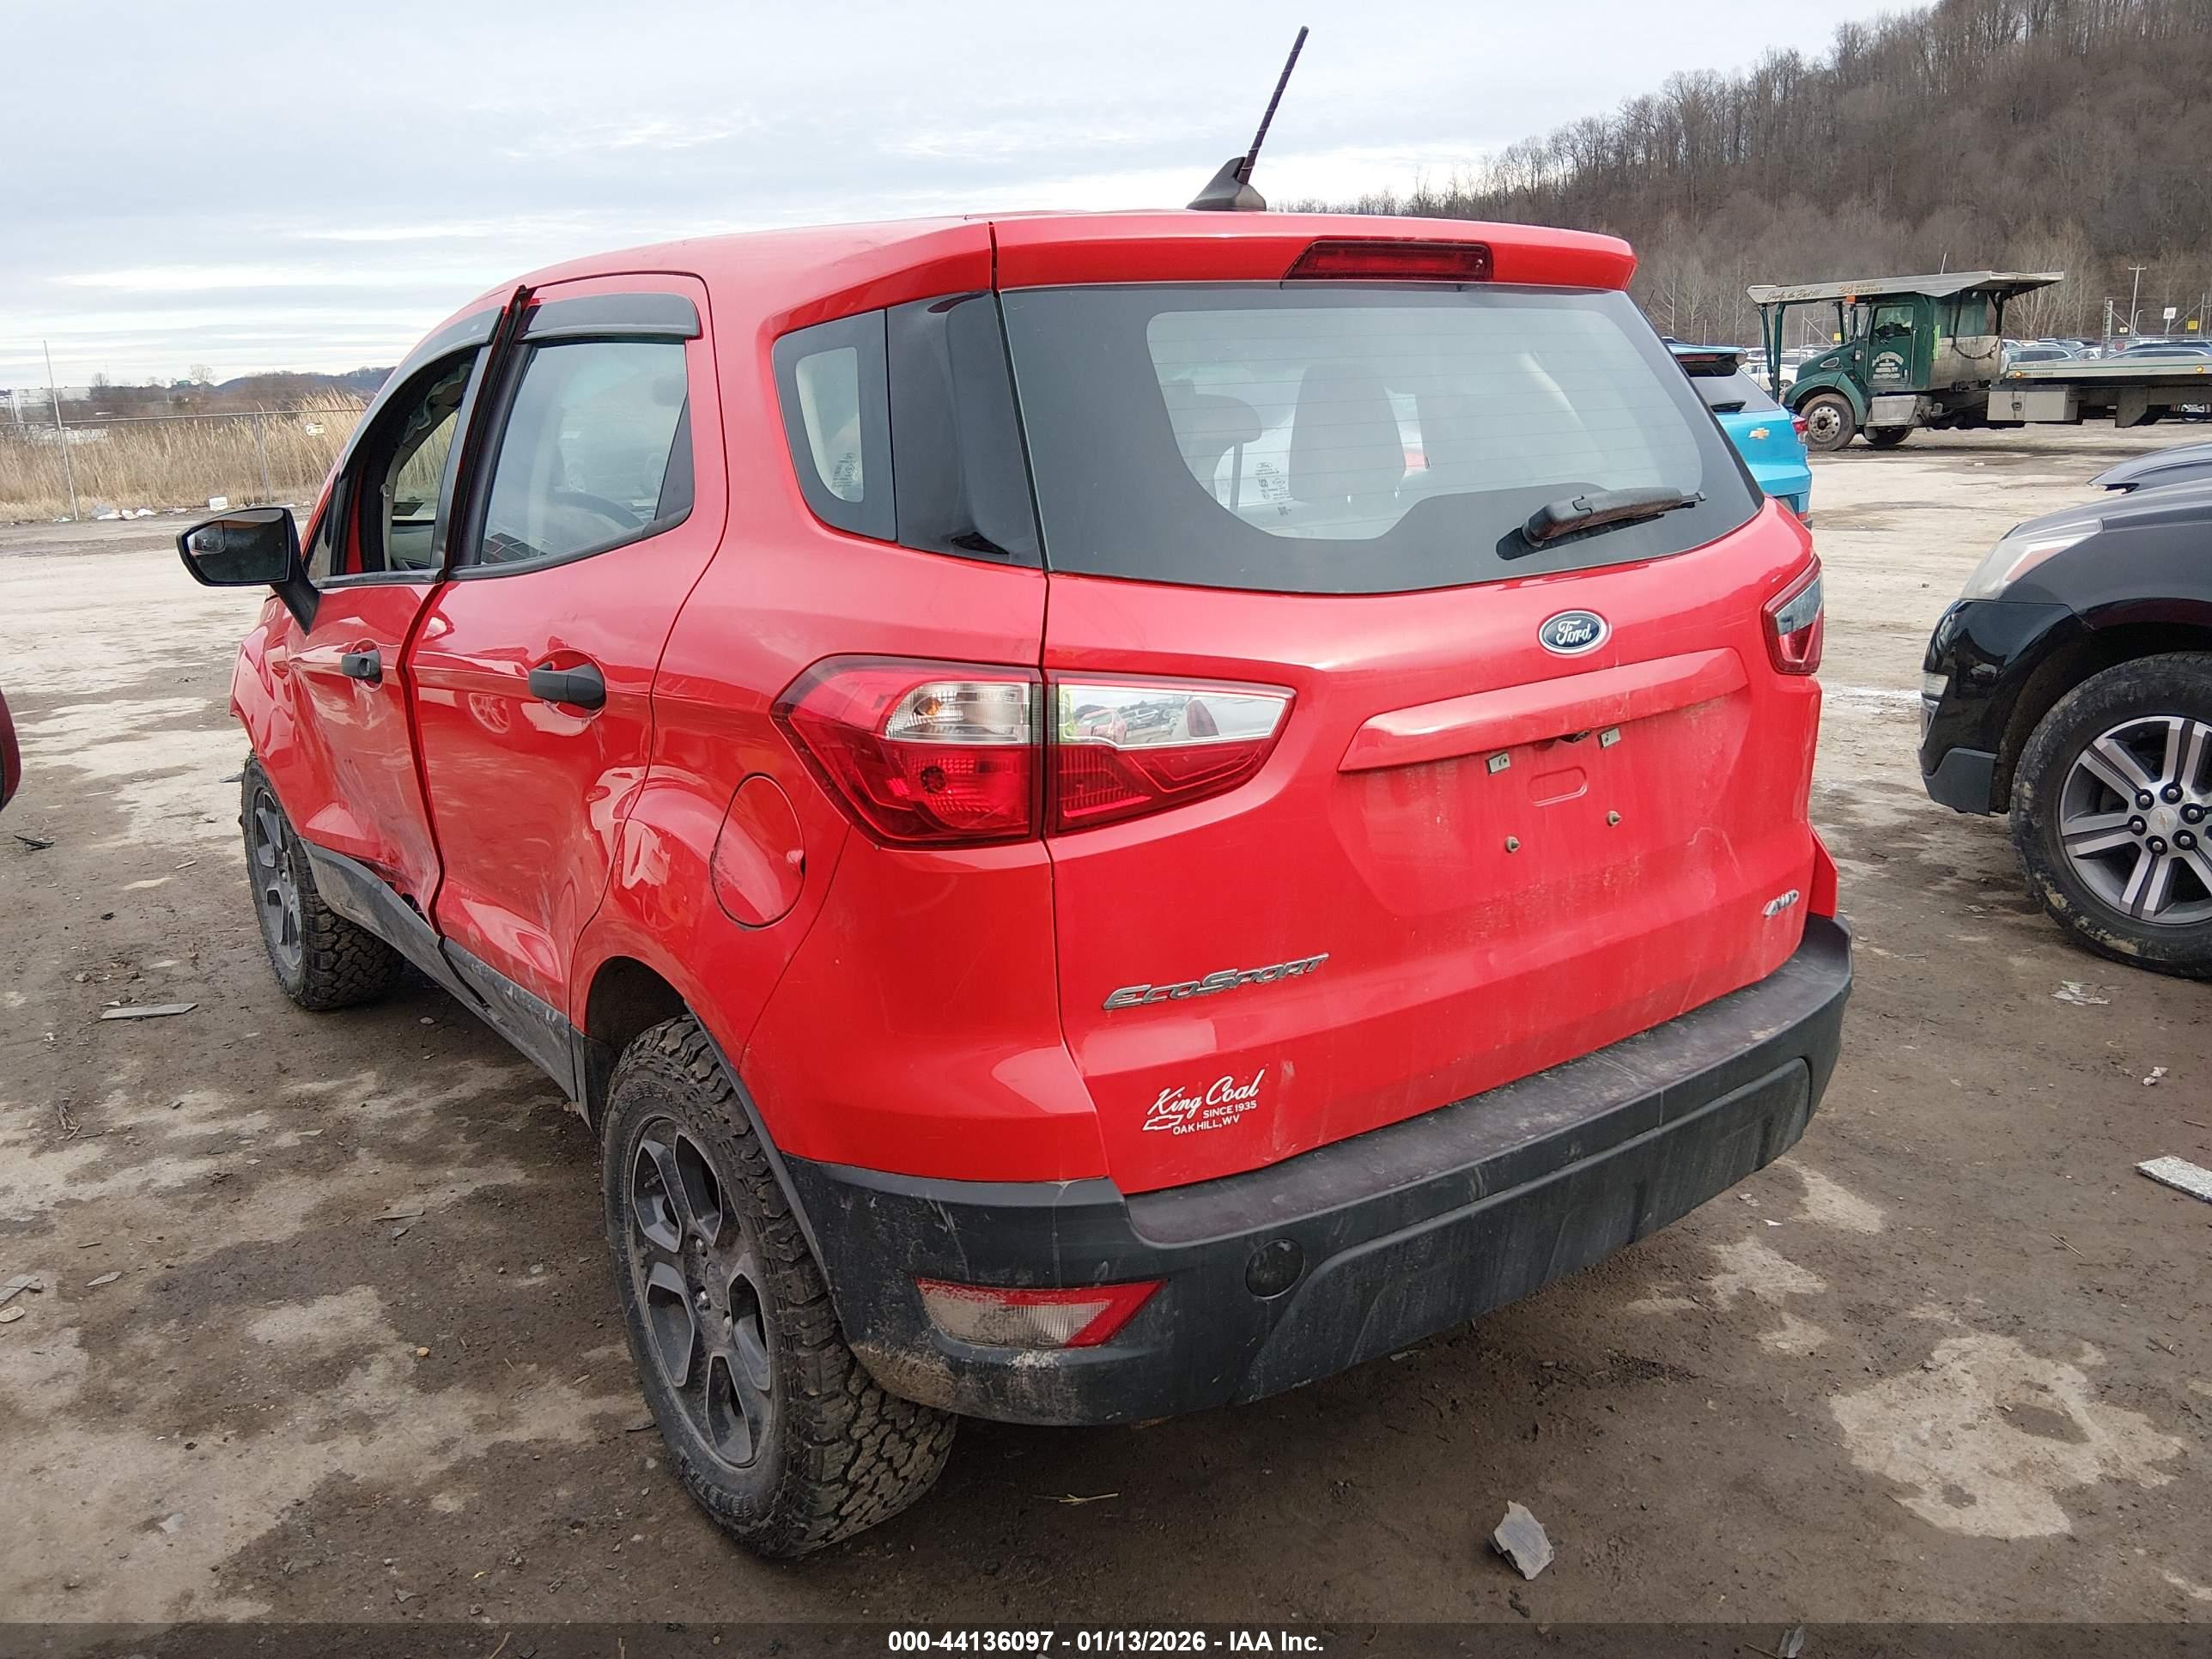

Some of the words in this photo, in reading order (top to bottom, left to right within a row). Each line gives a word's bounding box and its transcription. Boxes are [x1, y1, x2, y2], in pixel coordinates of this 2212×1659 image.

[1555, 619, 1592, 645] Ford
[1147, 1086, 1202, 1119] King
[1206, 1068, 1266, 1106] Coal
[1203, 1104, 1233, 1119] SINCE
[1235, 1100, 1257, 1112] 1935
[1173, 1123, 1195, 1135] OAK
